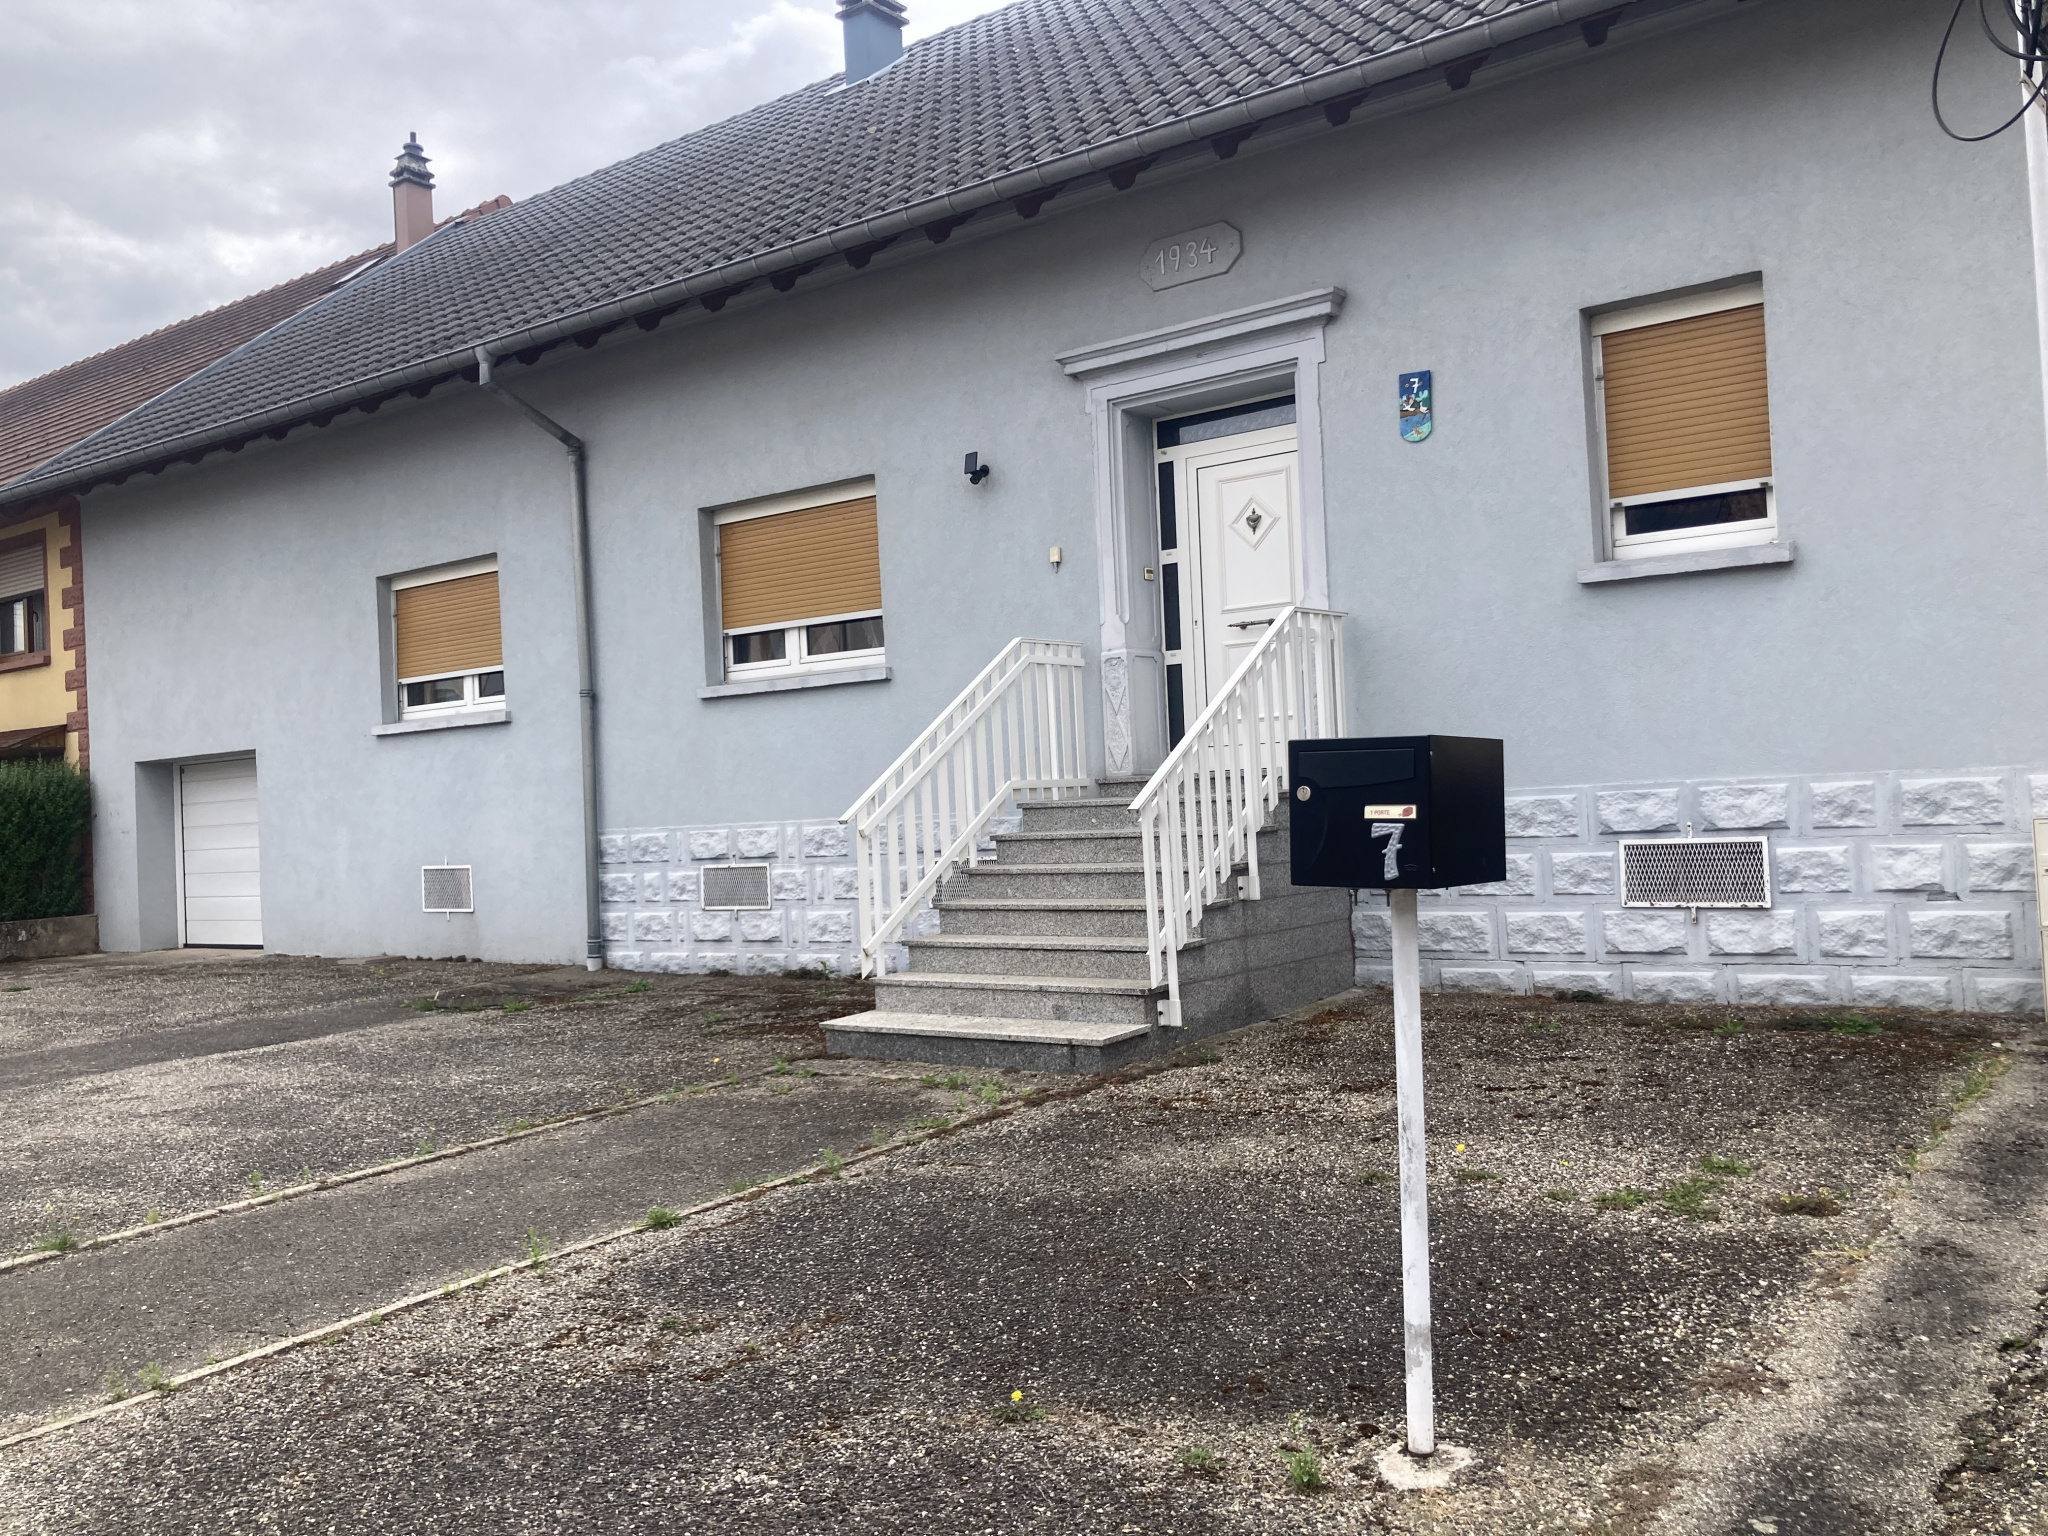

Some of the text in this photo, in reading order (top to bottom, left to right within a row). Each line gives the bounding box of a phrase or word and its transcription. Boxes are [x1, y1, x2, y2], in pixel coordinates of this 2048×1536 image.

[1155, 237, 1218, 275] 1934
[1410, 377, 1419, 393] 7
[1371, 823, 1405, 880] 7
